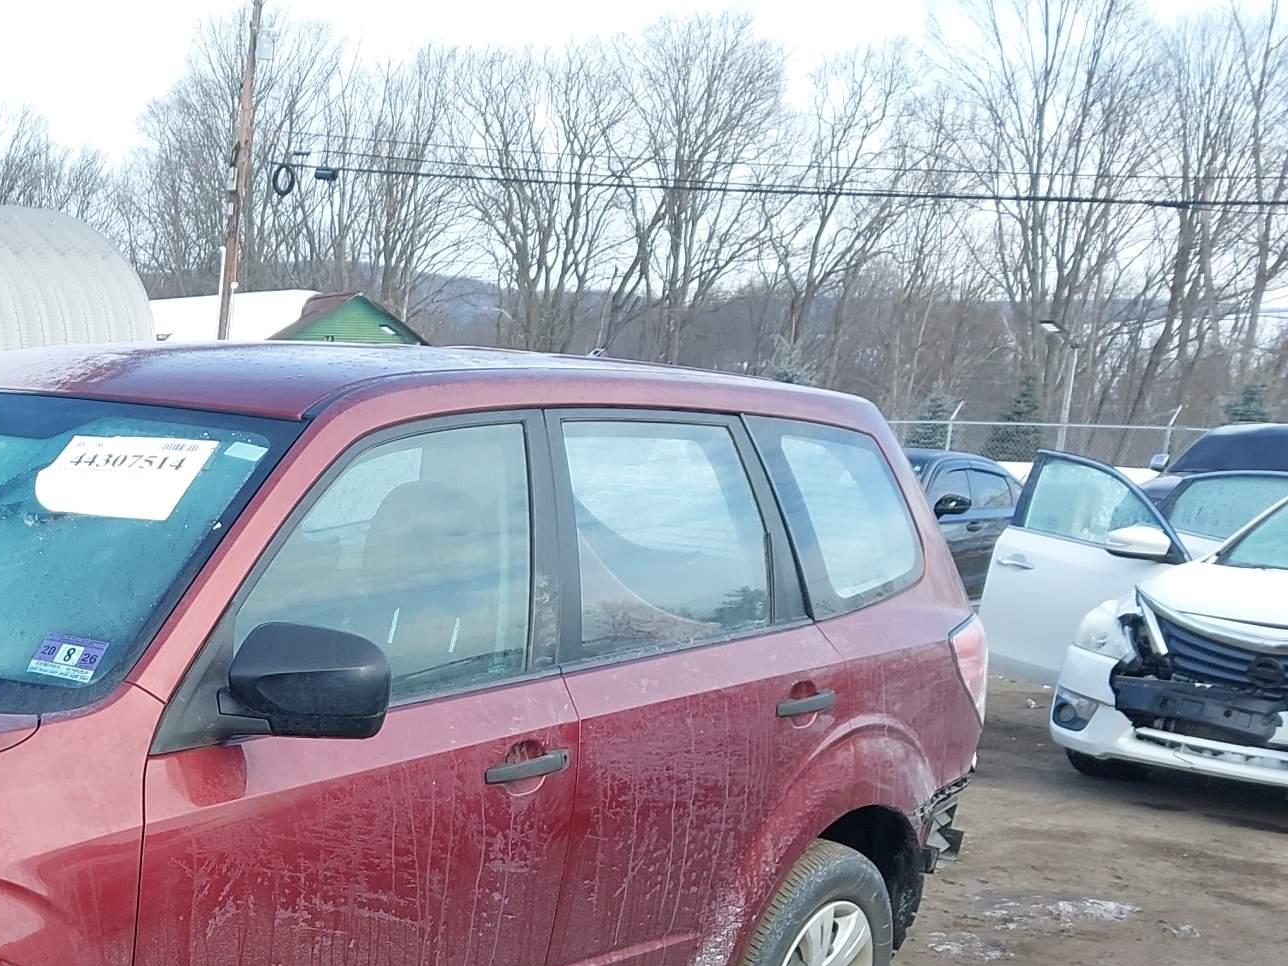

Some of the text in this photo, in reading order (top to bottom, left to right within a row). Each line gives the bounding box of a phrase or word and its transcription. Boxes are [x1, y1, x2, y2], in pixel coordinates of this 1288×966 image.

[69, 452, 186, 471] 44307514
[41, 645, 99, 665] 20 8 26
